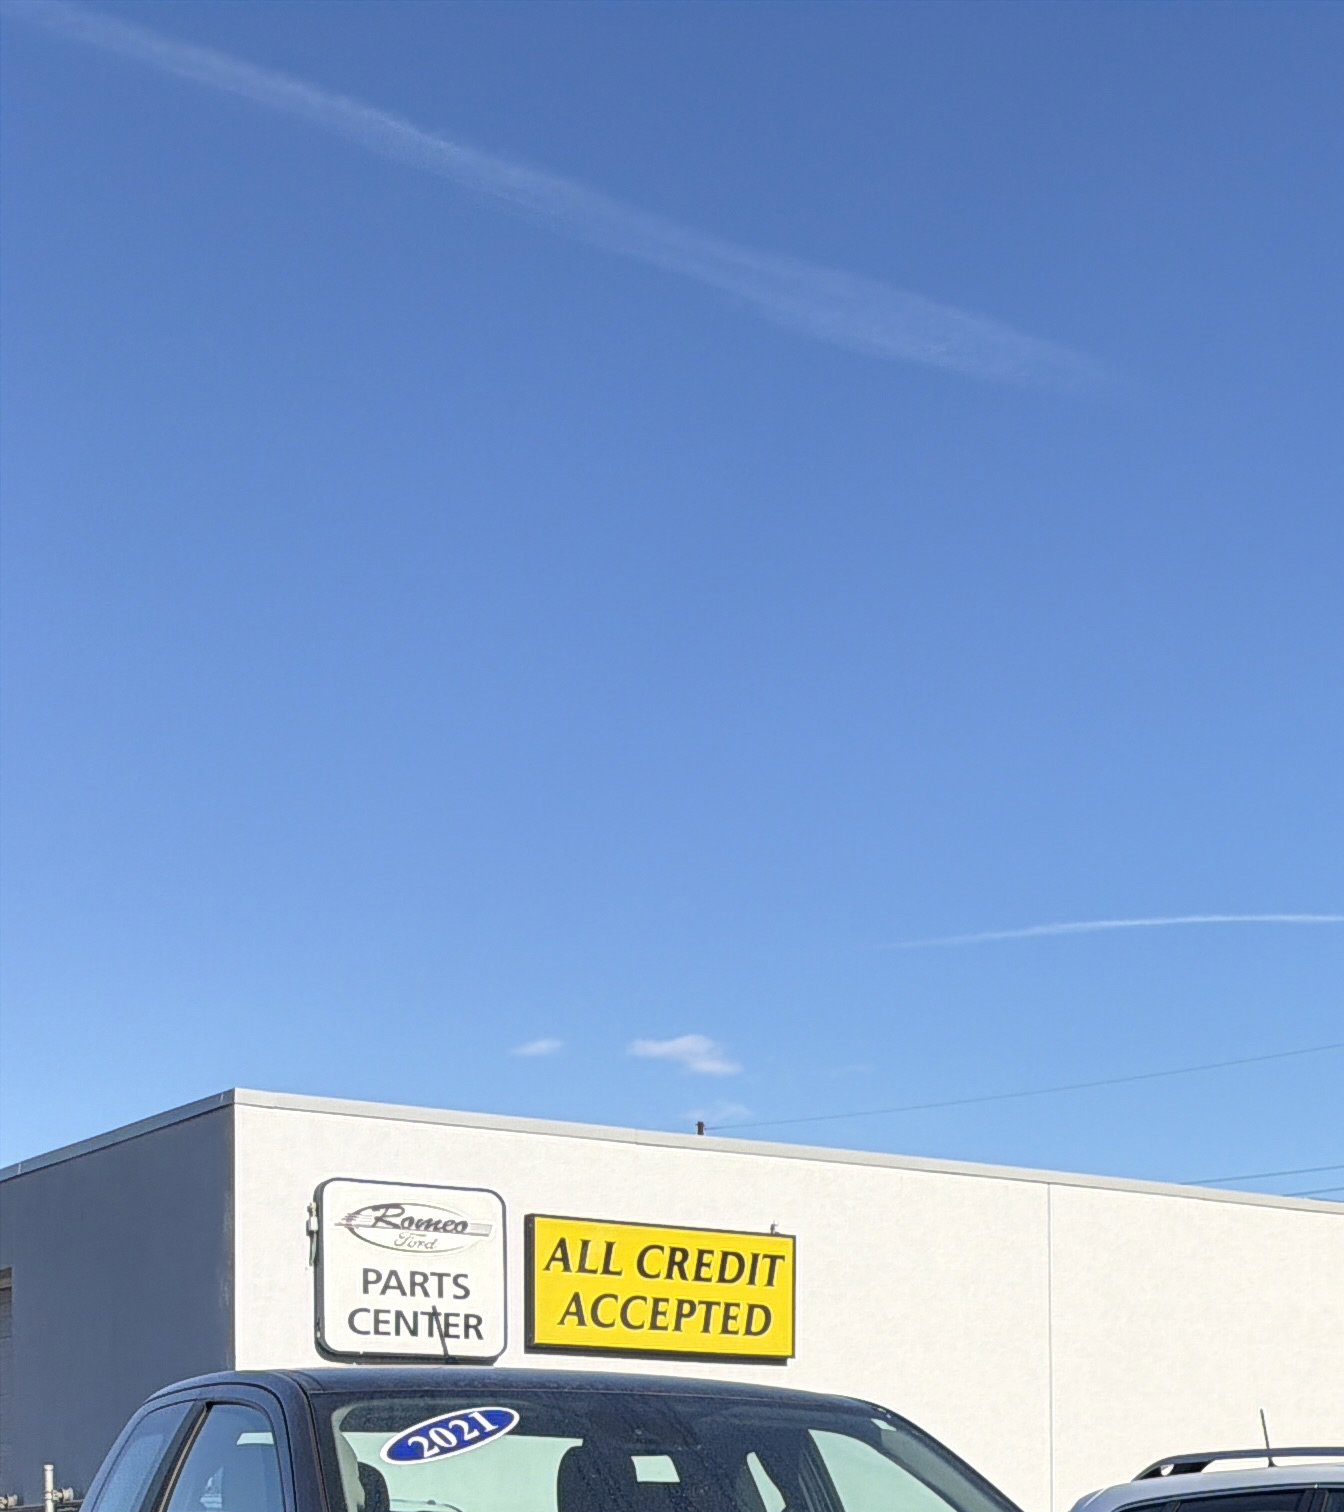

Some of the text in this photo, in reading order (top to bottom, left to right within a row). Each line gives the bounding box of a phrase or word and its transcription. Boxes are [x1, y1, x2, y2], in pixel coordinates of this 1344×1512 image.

[371, 1203, 468, 1233] Romeo
[394, 1231, 438, 1249] Ford
[543, 1237, 785, 1287] ALL CREDIT
[362, 1267, 471, 1300] PARTS
[347, 1307, 484, 1340] CENTER
[557, 1291, 772, 1336] ACCEPTED
[408, 1412, 499, 1458] 2021
